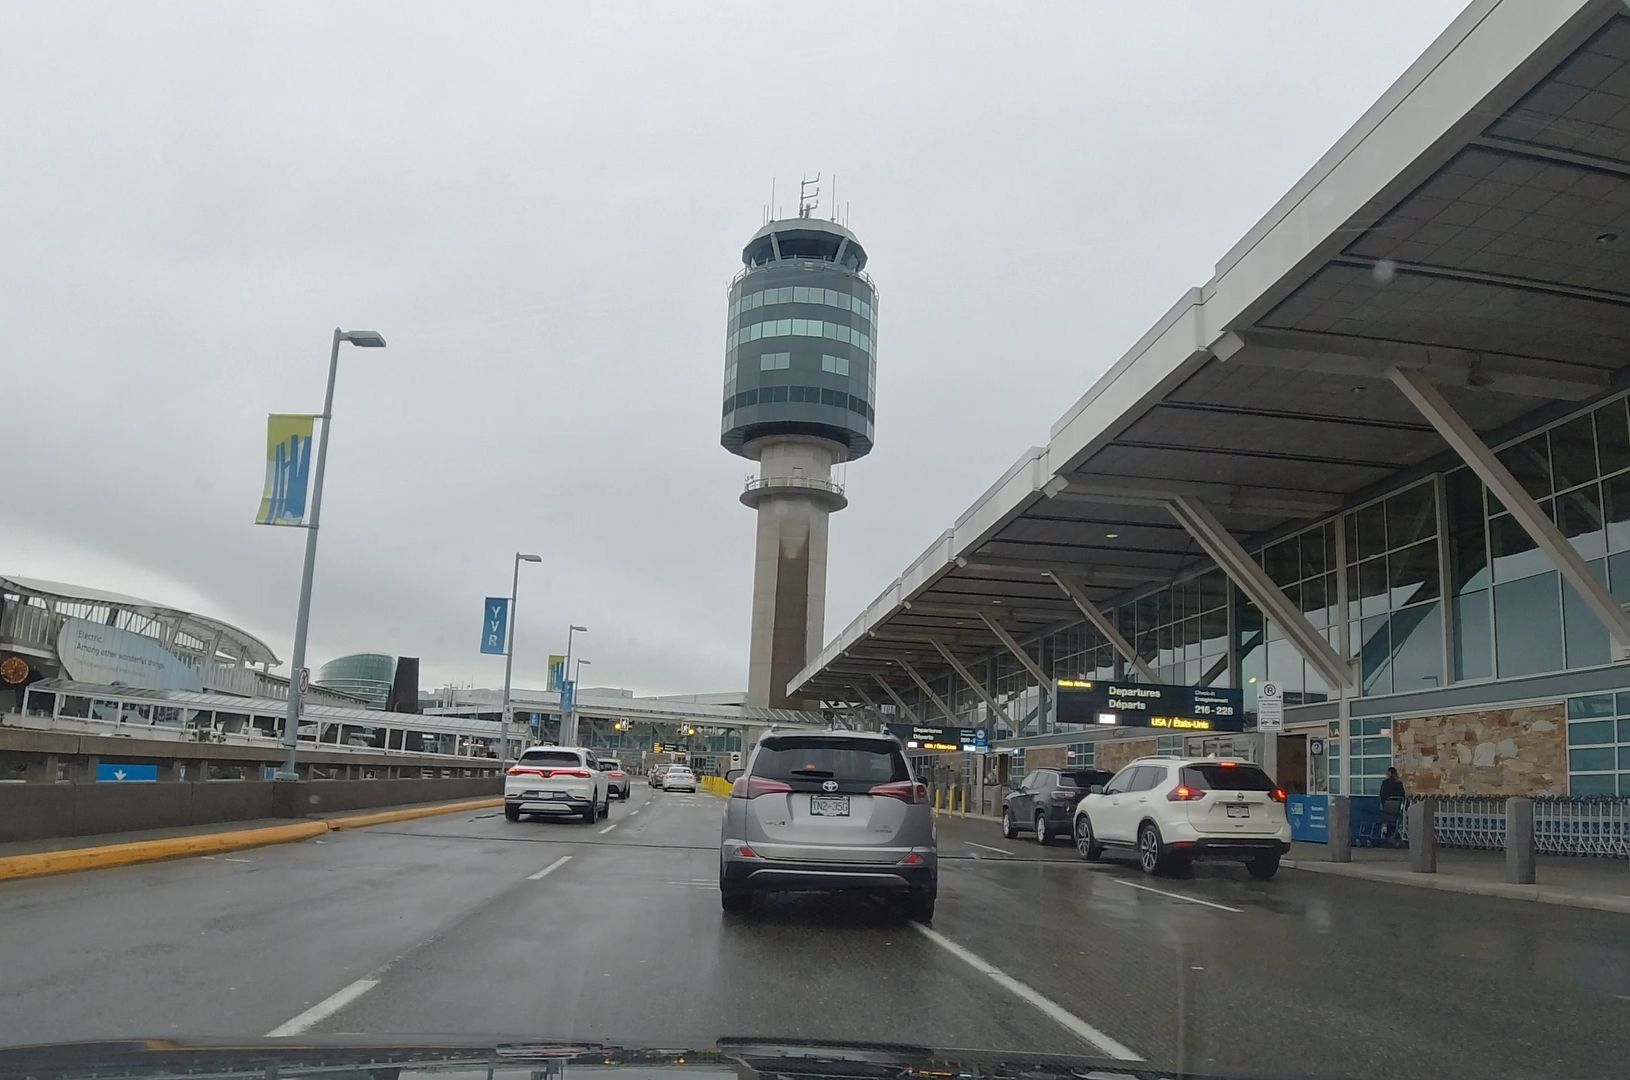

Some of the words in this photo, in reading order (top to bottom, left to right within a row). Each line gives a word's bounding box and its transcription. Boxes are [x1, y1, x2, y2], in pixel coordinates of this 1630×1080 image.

[488, 605, 502, 646] YVR
[76, 642, 99, 657] Among
[1108, 686, 1161, 698] Departures
[1108, 699, 1146, 710] Départs
[1151, 717, 1167, 727] USA
[1173, 717, 1209, 729] États-Unis
